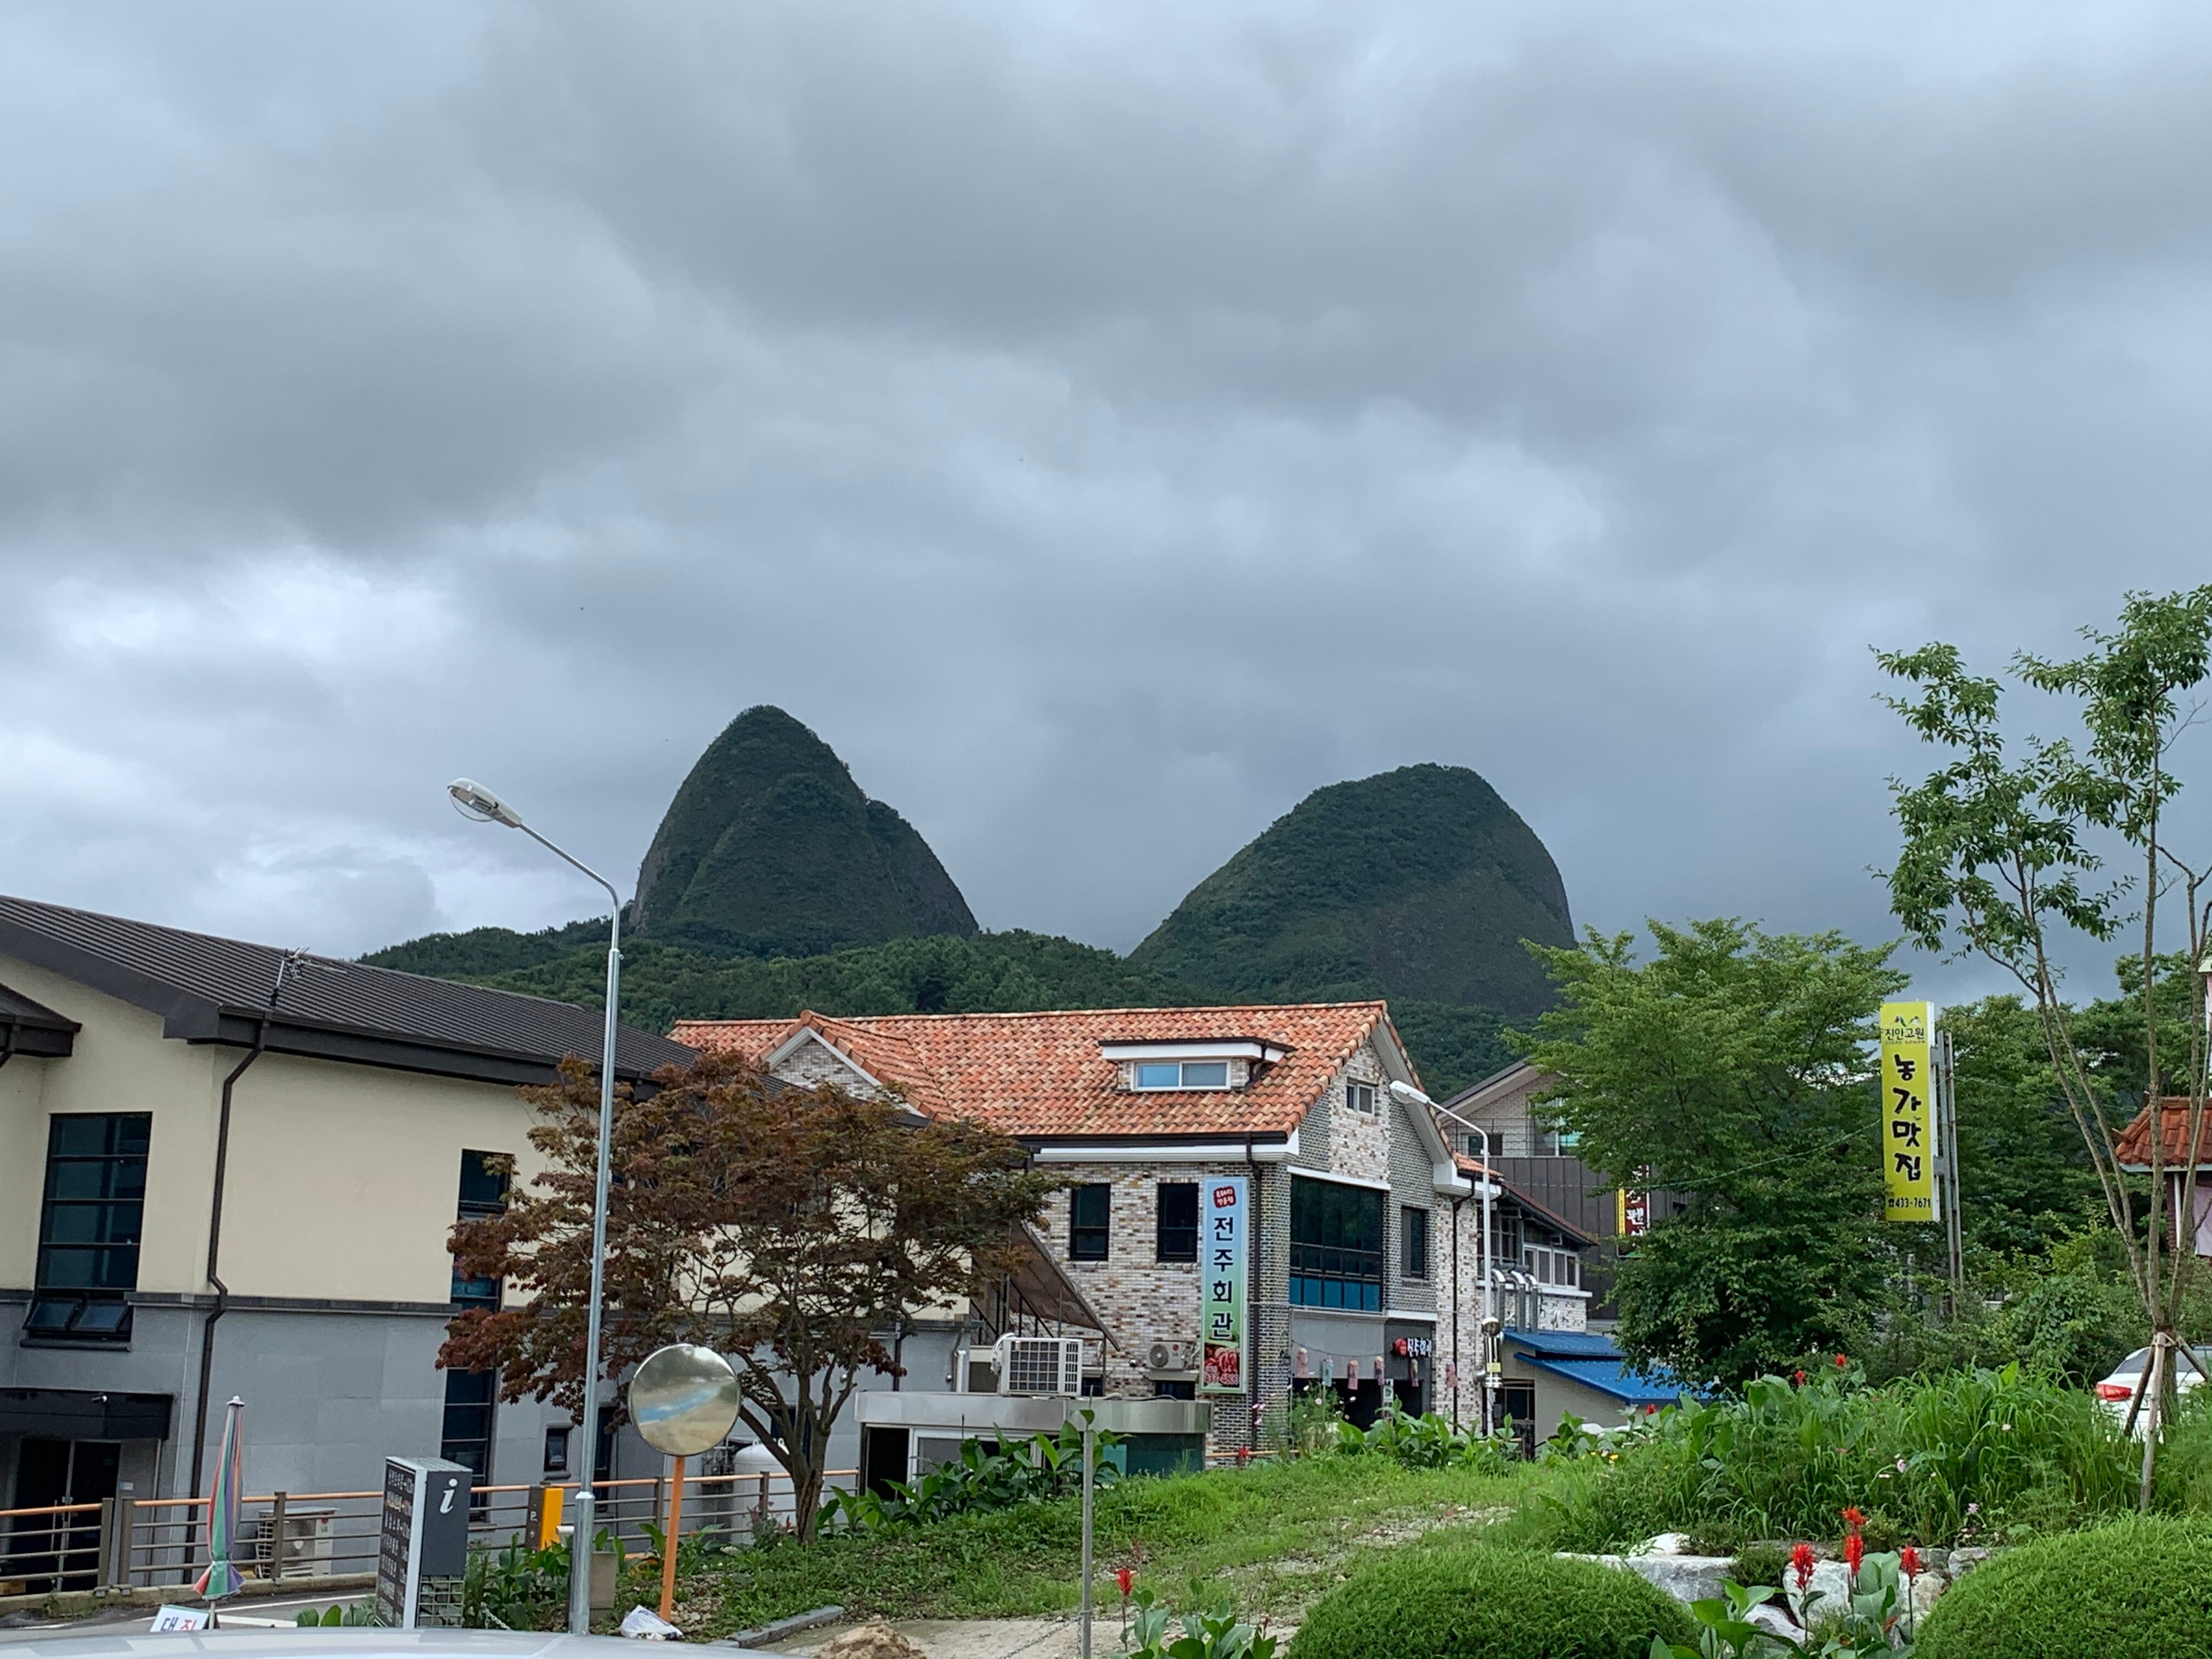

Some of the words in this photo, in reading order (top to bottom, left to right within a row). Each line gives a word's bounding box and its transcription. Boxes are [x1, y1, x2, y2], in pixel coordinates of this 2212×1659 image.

[1885, 1028, 1924, 1040] 진안고원
[1892, 1054, 1921, 1181] 농가맛집
[1895, 1197, 1931, 1207] 433-7671
[1212, 1217, 1234, 1337] 전주회관
